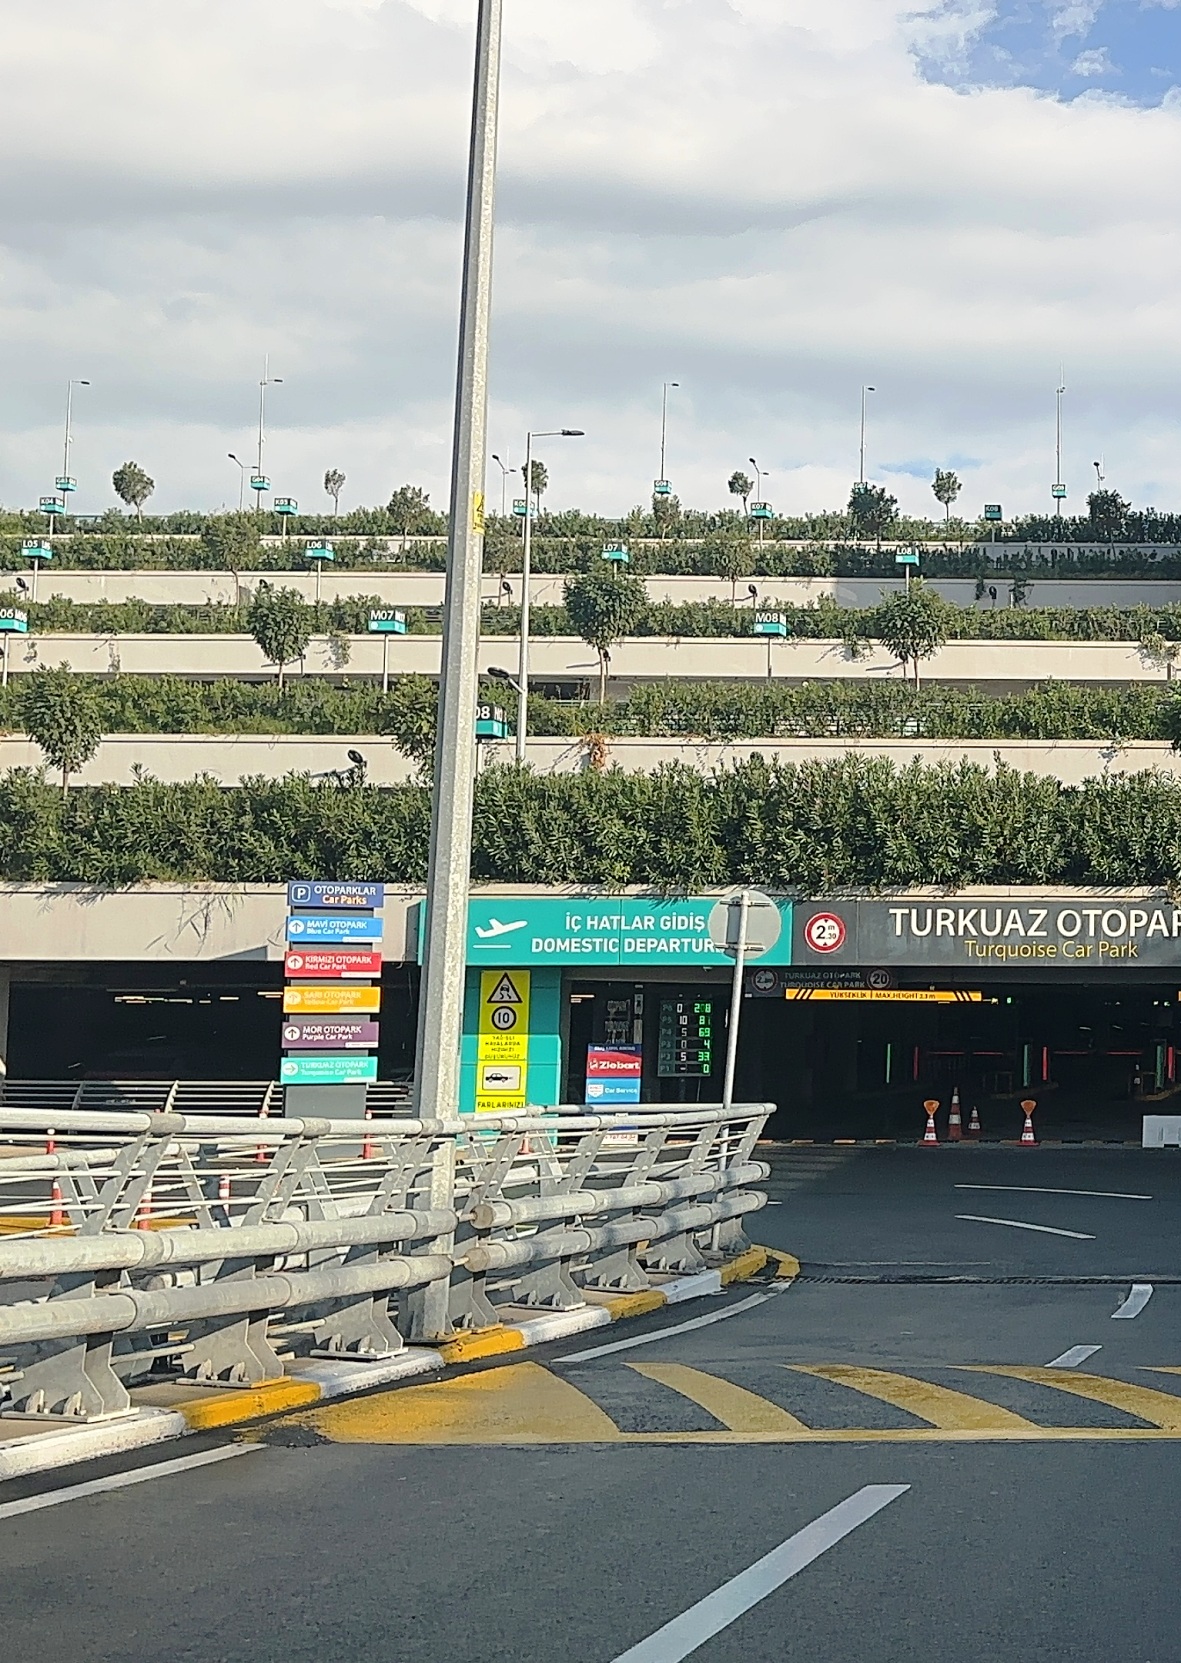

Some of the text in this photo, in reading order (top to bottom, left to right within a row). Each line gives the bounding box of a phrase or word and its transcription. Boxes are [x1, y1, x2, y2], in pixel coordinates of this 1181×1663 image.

[22, 540, 38, 548] L05
[306, 541, 322, 549] L06
[896, 547, 912, 555] L08
[0, 608, 14, 619] 06
[370, 610, 394, 620] M07
[755, 612, 778, 622] M08
[314, 885, 376, 896] OTOPARKLAR
[322, 895, 367, 904] Car Parks
[307, 919, 367, 929] MAVİ OTOPARK
[565, 911, 706, 933] İÇ HATLAR GİDİŞ
[888, 908, 1049, 938] TURKUAZ
[531, 937, 725, 954] DOMESTIC DEPARTUR
[964, 940, 1139, 961] Turquoise Car Park
[336, 956, 372, 964] OTOPARK
[872, 973, 887, 985] 20
[780, 981, 825, 989] TURQUOISE
[844, 980, 865, 988] PARK
[324, 991, 362, 999] OTOPARK
[677, 1003, 683, 1013] 0
[498, 1012, 510, 1024] 10
[679, 1015, 688, 1025] 10
[302, 1033, 324, 1041] Purple
[681, 1028, 688, 1037] 5
[698, 1027, 711, 1037] 69
[681, 1040, 687, 1049] 0
[703, 1039, 711, 1049] 4
[680, 1052, 687, 1061] 5
[698, 1052, 710, 1061] 33
[335, 1061, 368, 1069] OTOPARK
[703, 1064, 710, 1073] 0
